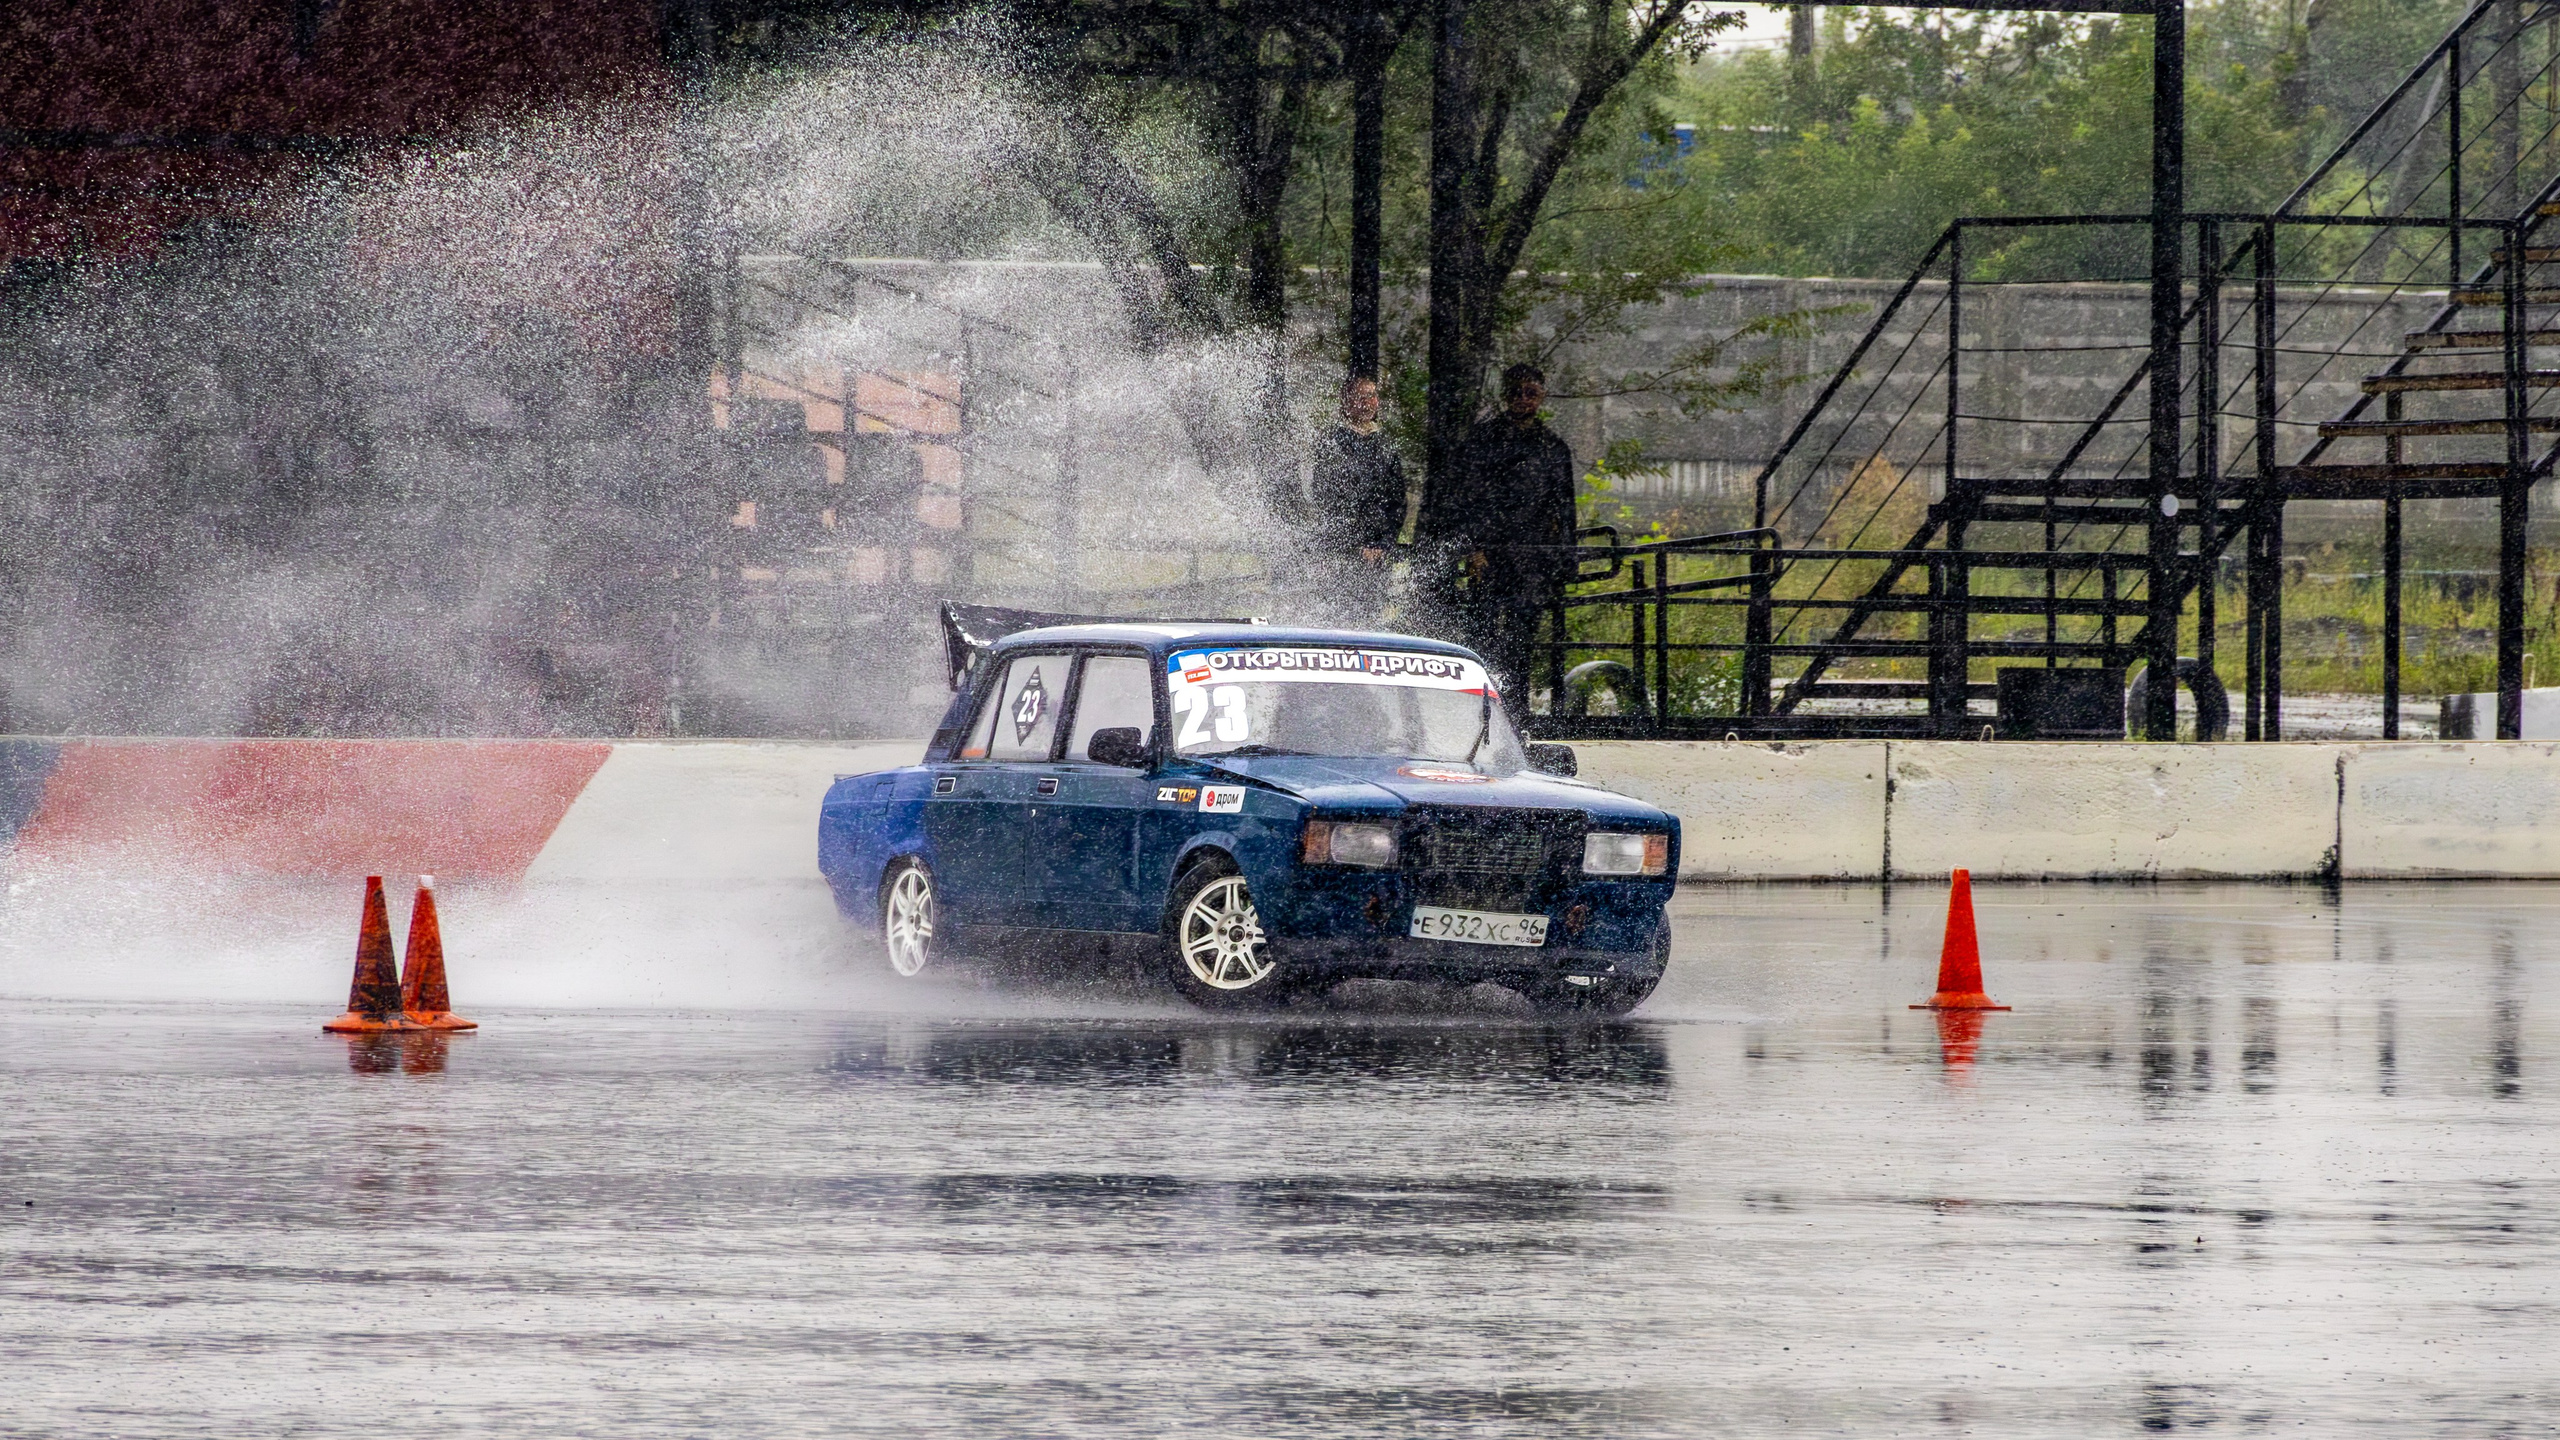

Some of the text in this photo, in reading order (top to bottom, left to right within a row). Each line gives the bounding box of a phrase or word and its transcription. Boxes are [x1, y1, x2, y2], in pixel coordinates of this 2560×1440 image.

[1207, 648, 1465, 680] ОТКРЫТЫЙ ДРИФТ
[1016, 689, 1041, 723] 23
[1173, 685, 1249, 750] 23
[1156, 787, 1197, 803] ZIC TOP
